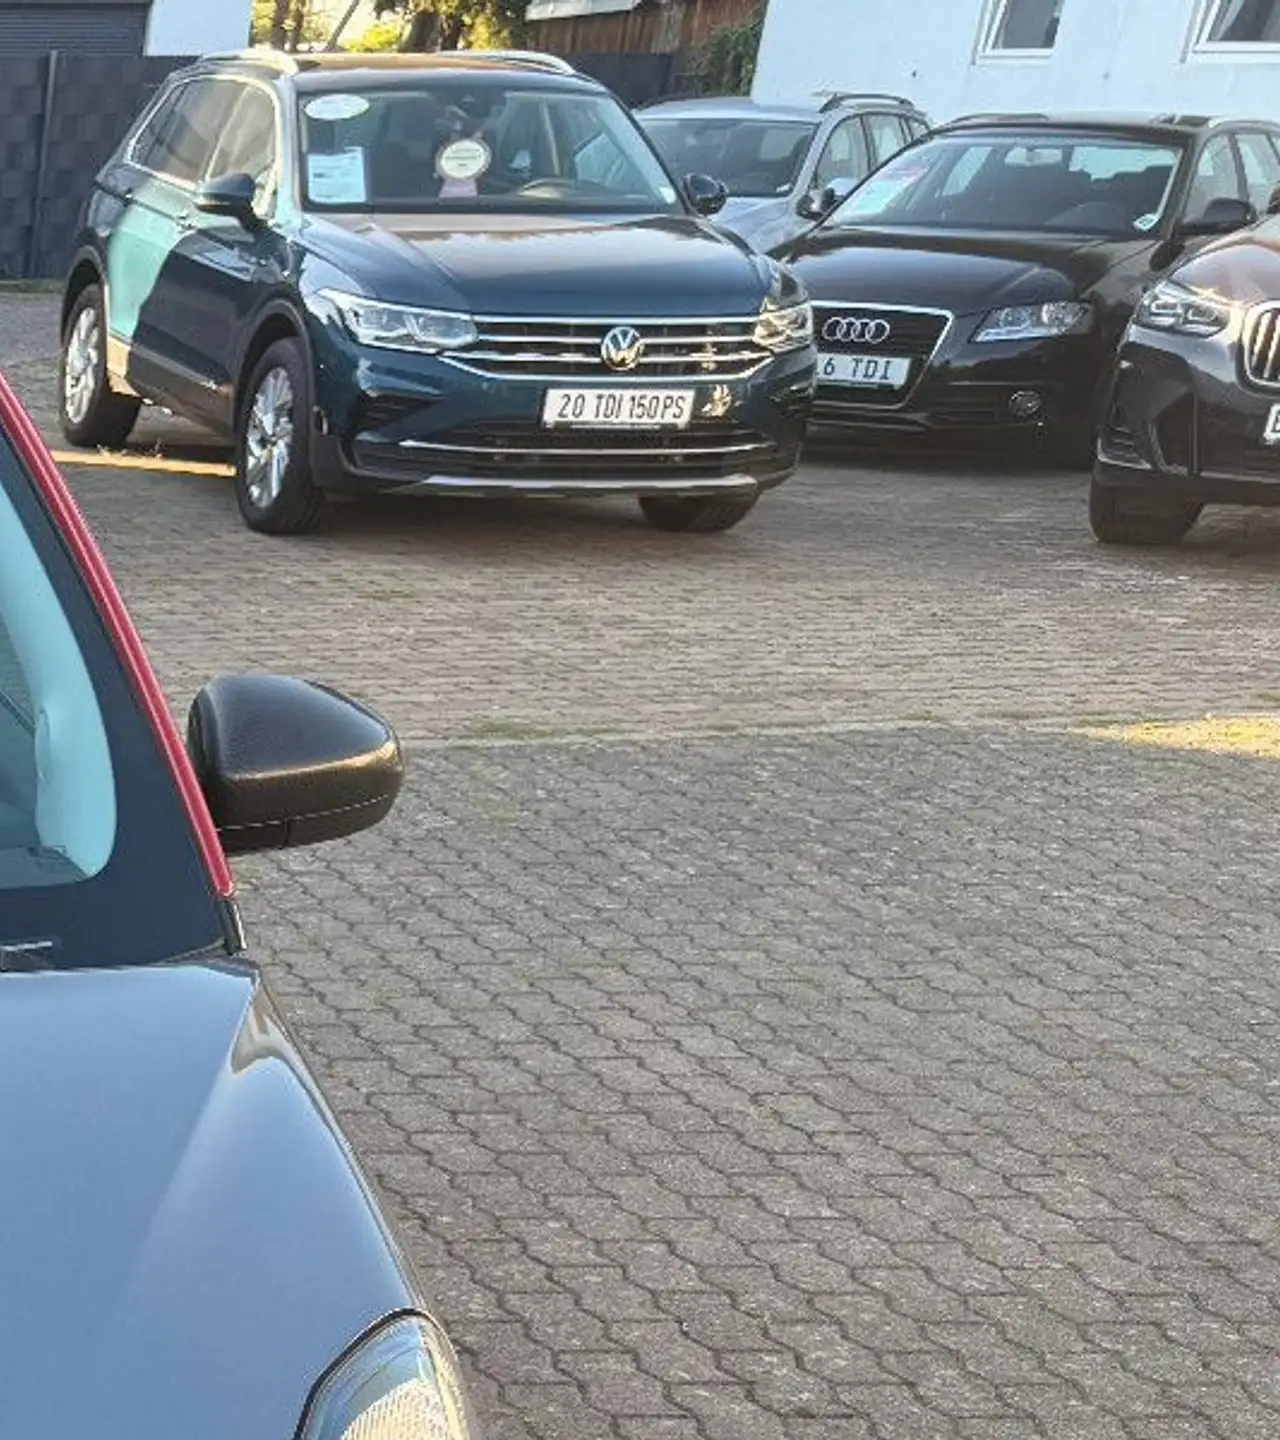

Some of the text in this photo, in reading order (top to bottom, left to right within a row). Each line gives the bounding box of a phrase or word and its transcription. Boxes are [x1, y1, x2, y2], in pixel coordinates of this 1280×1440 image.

[851, 358, 891, 380] TDI
[557, 393, 586, 419] 20
[593, 394, 624, 419] TDI
